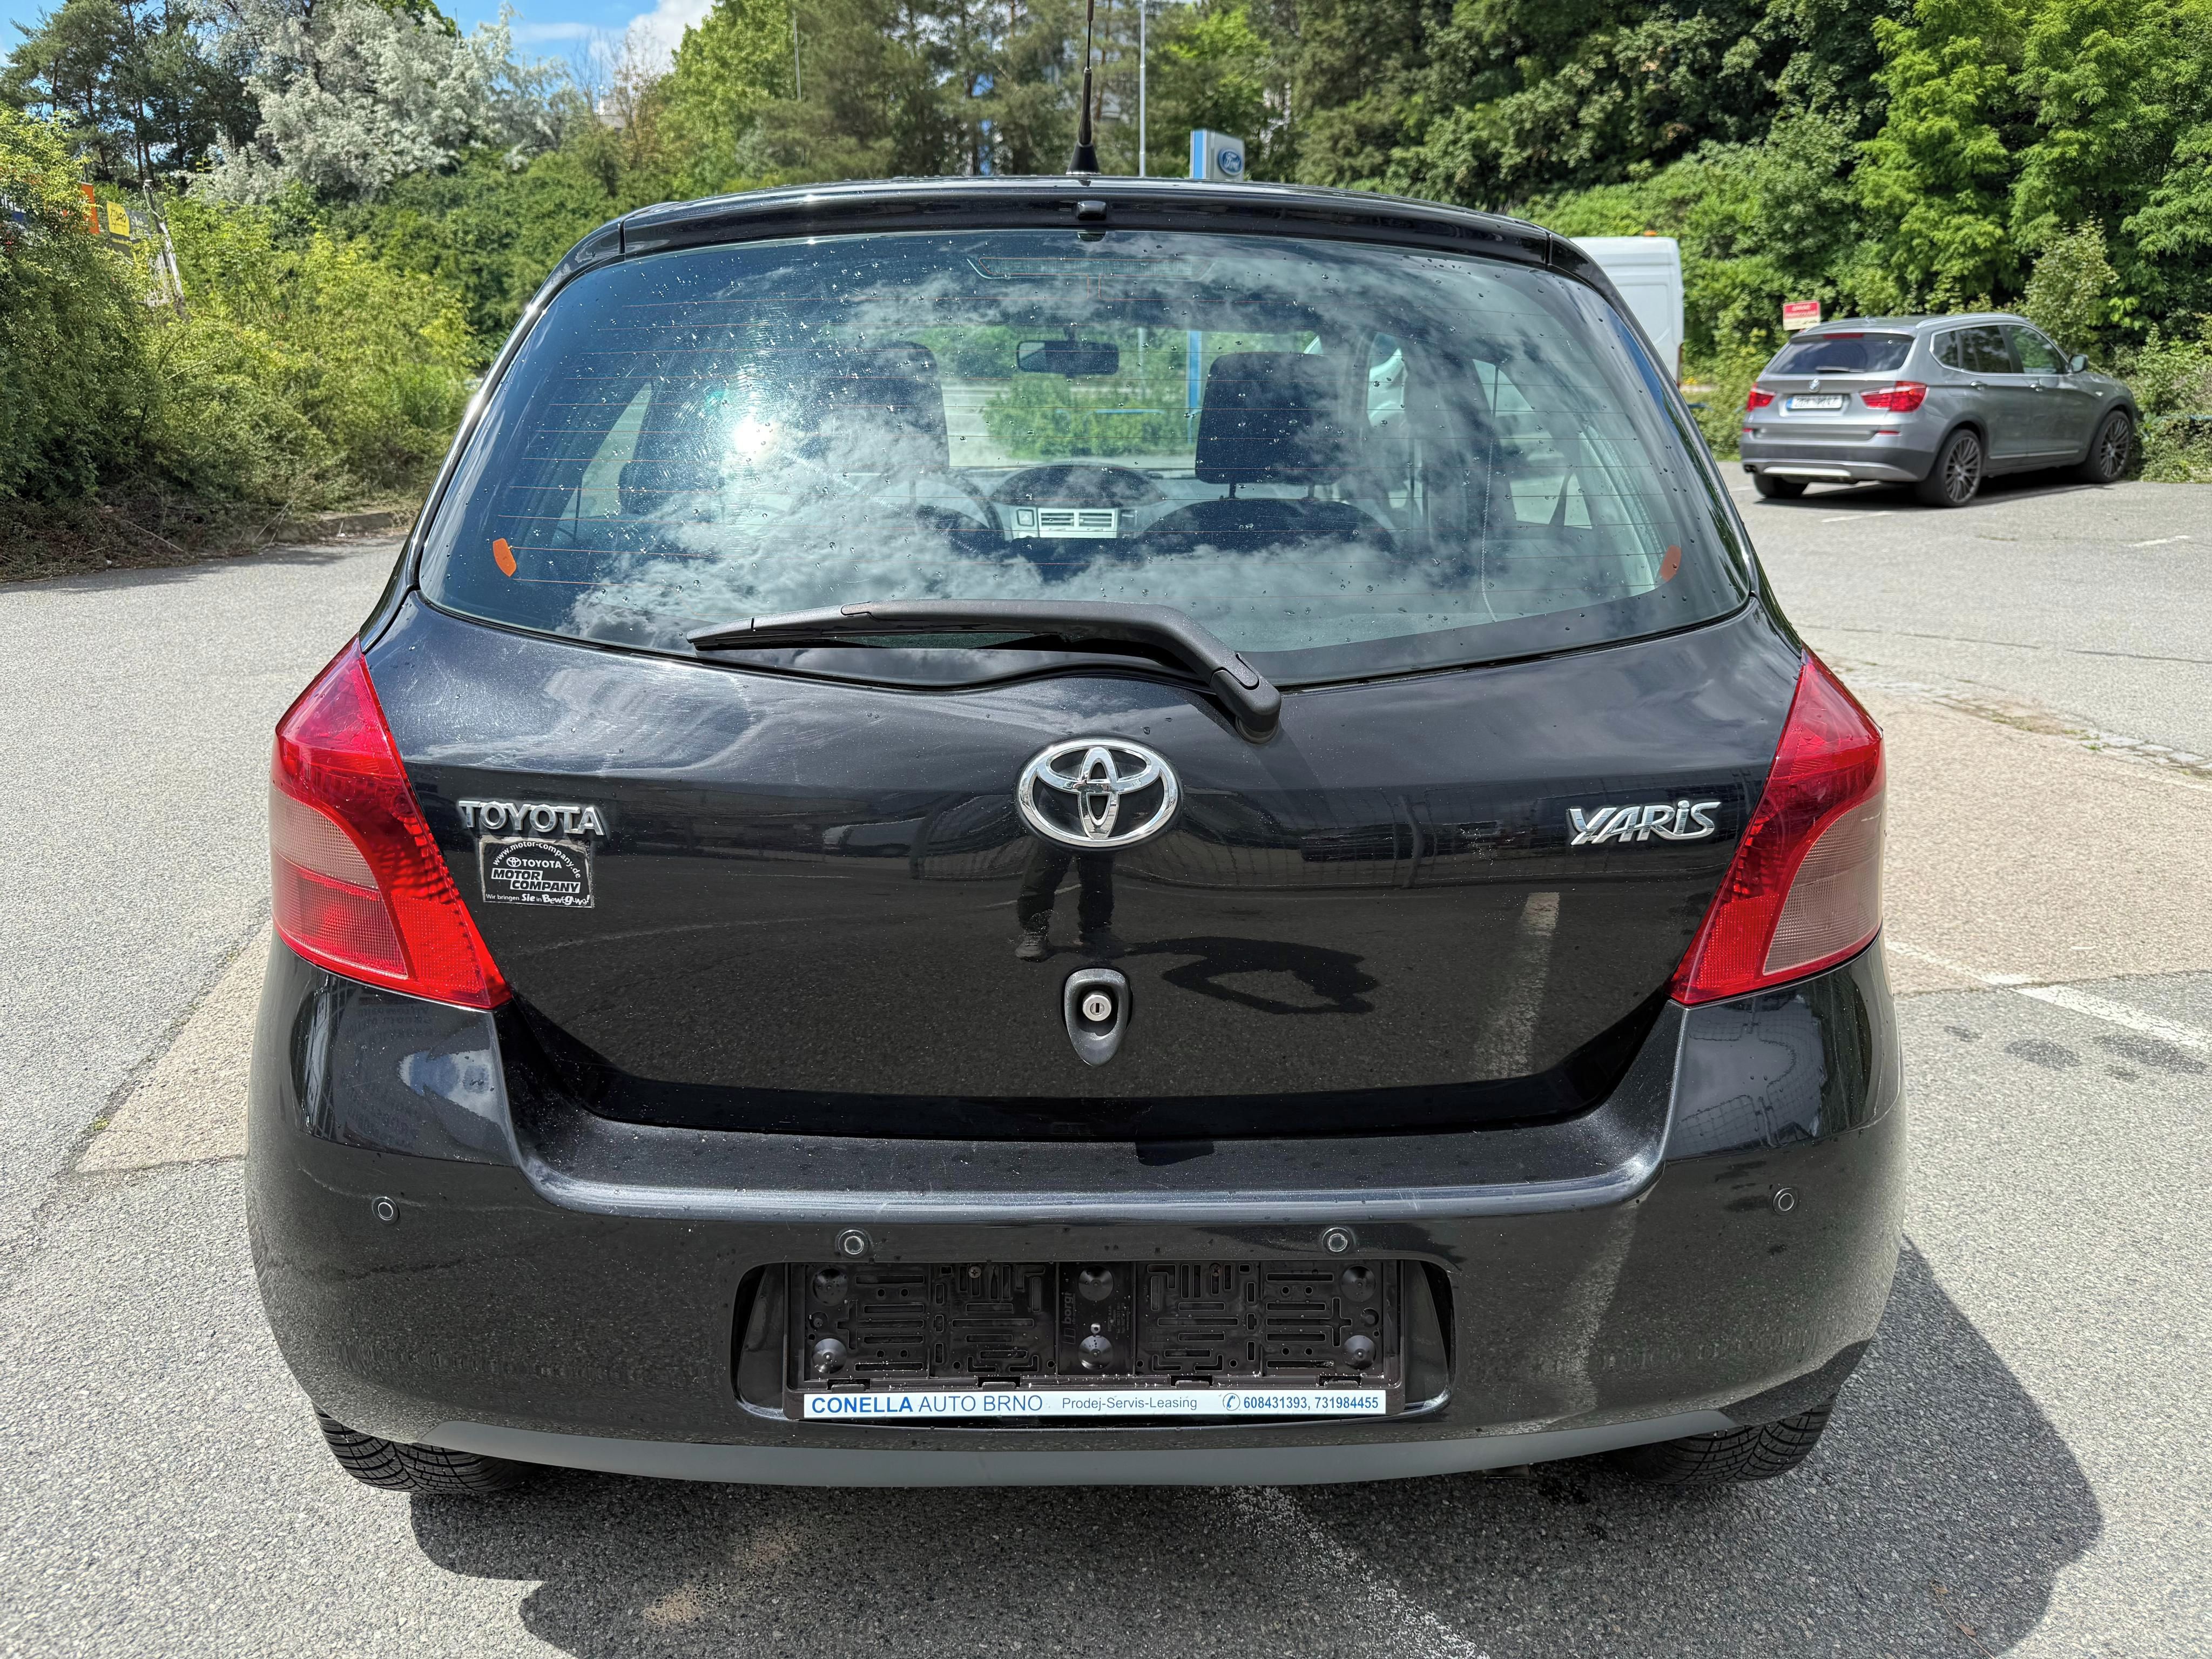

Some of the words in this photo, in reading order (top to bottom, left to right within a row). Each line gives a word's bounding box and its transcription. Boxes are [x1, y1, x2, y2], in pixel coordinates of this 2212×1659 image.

[458, 800, 605, 835] TOYOTA
[493, 841, 581, 879] www.motor-company.de
[522, 859, 562, 869] TOYOTA
[493, 869, 541, 880] MOTOR
[512, 880, 579, 892] COMPANY
[521, 893, 535, 902] Sie
[1062, 1292, 1073, 1325] borgi
[811, 1397, 913, 1413] CONELLA
[919, 1395, 976, 1412] AUTO
[983, 1395, 1043, 1412] BRNO
[1062, 1397, 1197, 1411] Prodej-Servis-Leasing
[1244, 1396, 1311, 1411] 608431393,
[1314, 1396, 1379, 1408] 731984455
